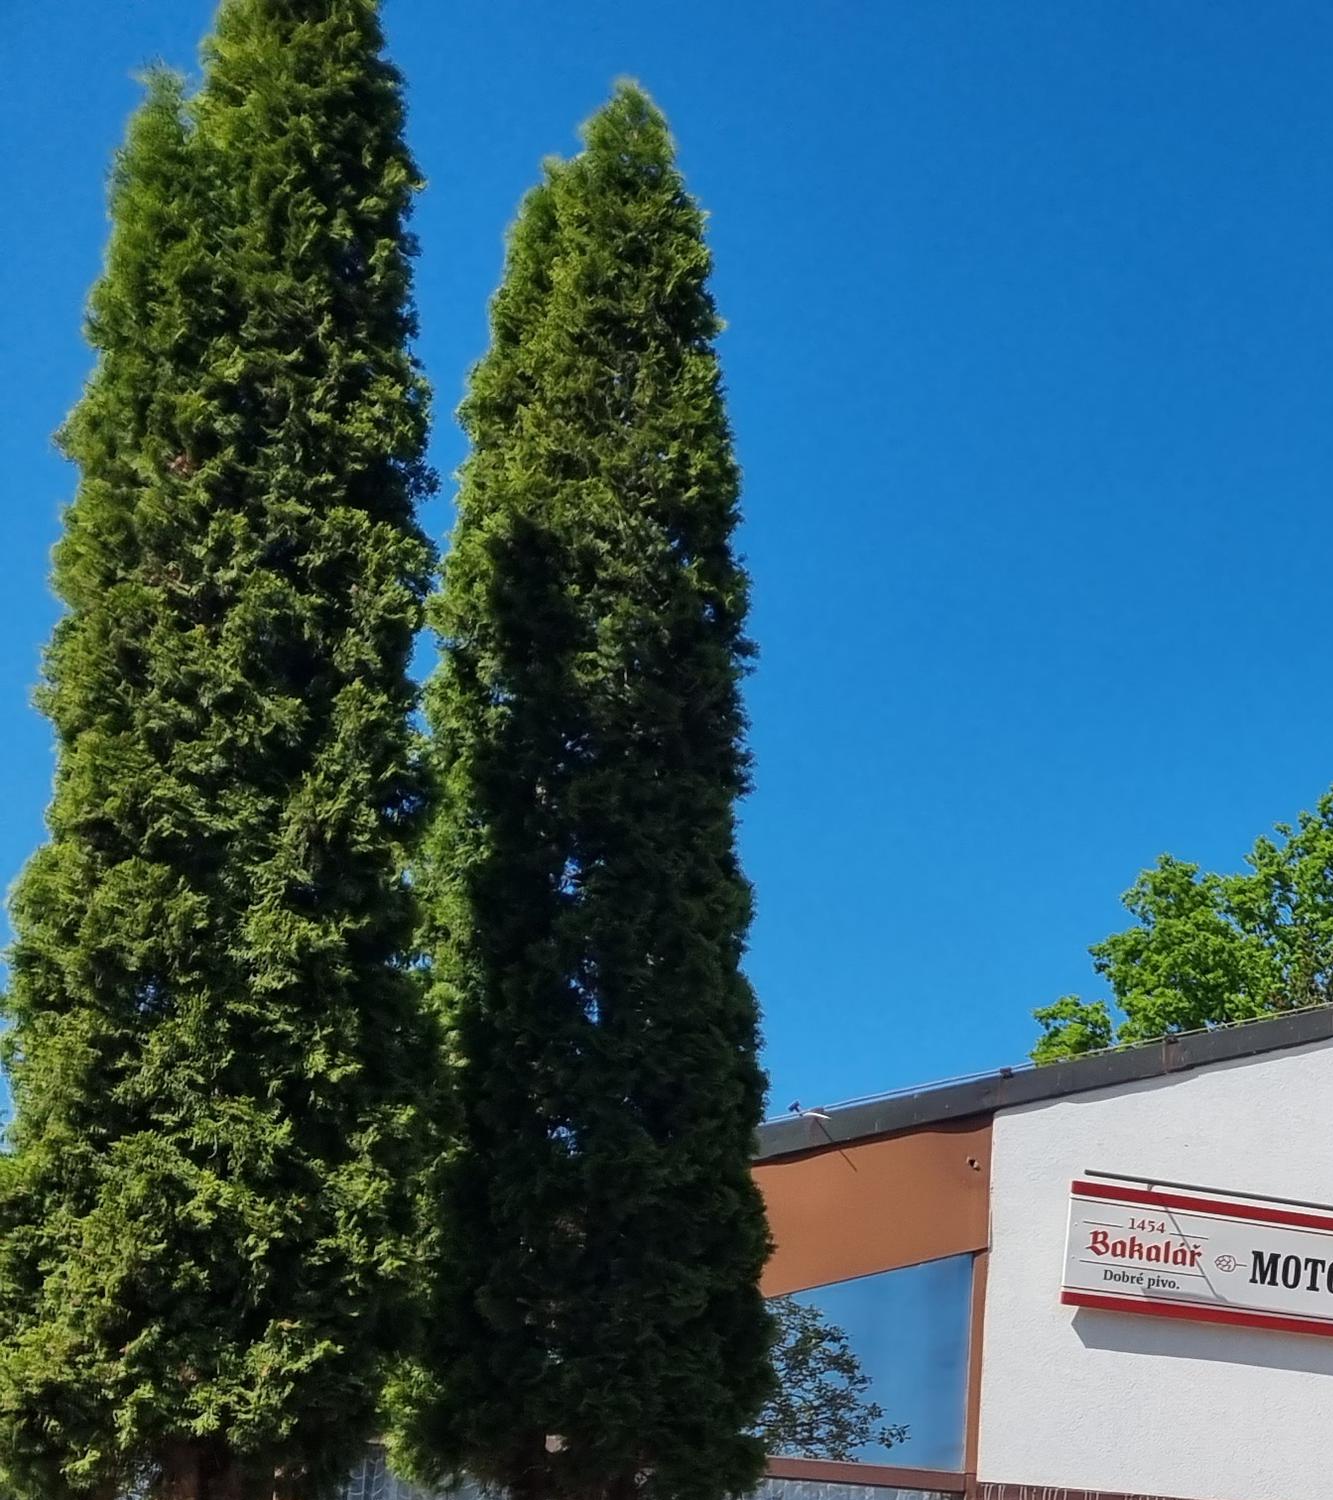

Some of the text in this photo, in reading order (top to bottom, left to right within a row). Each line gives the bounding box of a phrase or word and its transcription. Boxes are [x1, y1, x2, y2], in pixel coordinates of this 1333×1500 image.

[1128, 1217, 1166, 1234] 1454
[1085, 1230, 1202, 1268] Bakalář
[1102, 1269, 1180, 1291] Dobré pivo.
